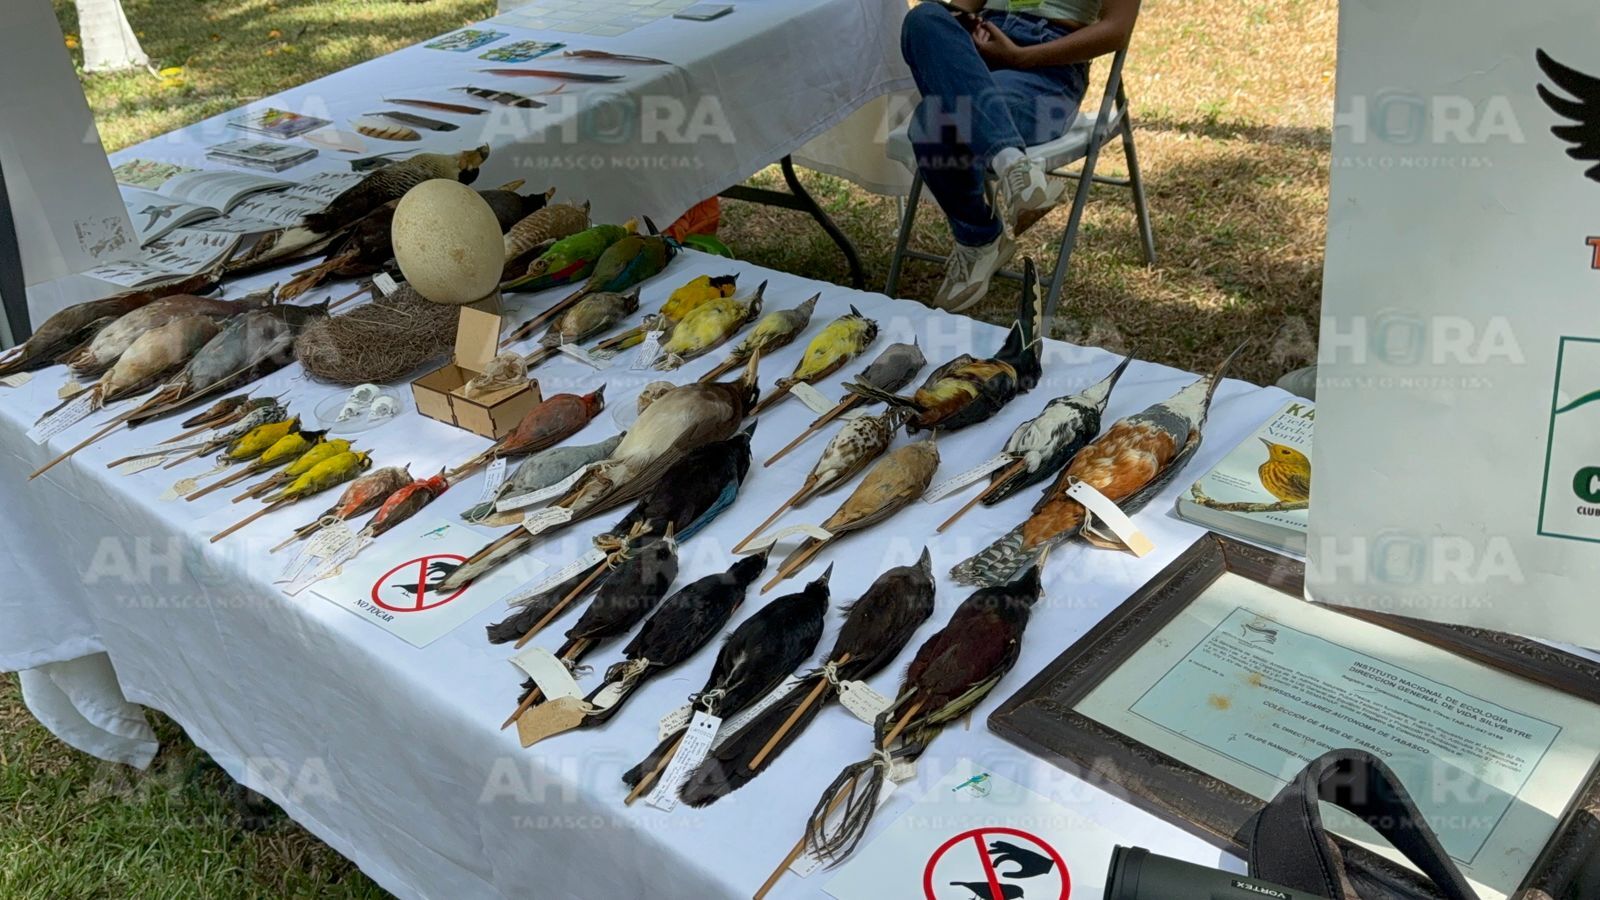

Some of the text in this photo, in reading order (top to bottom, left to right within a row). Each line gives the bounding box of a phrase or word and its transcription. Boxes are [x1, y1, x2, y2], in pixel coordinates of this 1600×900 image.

[1286, 403, 1316, 420] KA
[354, 599, 394, 622] NO TOCAR
[1348, 665, 1533, 740] DIRECCION GENERAL DE VIDA SILVESTRE
[1353, 660, 1509, 725] INSTITUTO NACIONAL DE ECOLOGIA
[1262, 700, 1307, 721] COLECCION
[1319, 723, 1341, 735] AVES
[1353, 736, 1392, 757] TABASCO
[1281, 726, 1316, 743] DIRECTOR
[1300, 699, 1332, 716] JUAREZ
[1331, 709, 1378, 733] AUTONOMA
[1391, 733, 1430, 754] TABASCO
[1236, 881, 1286, 899] VORTEX
